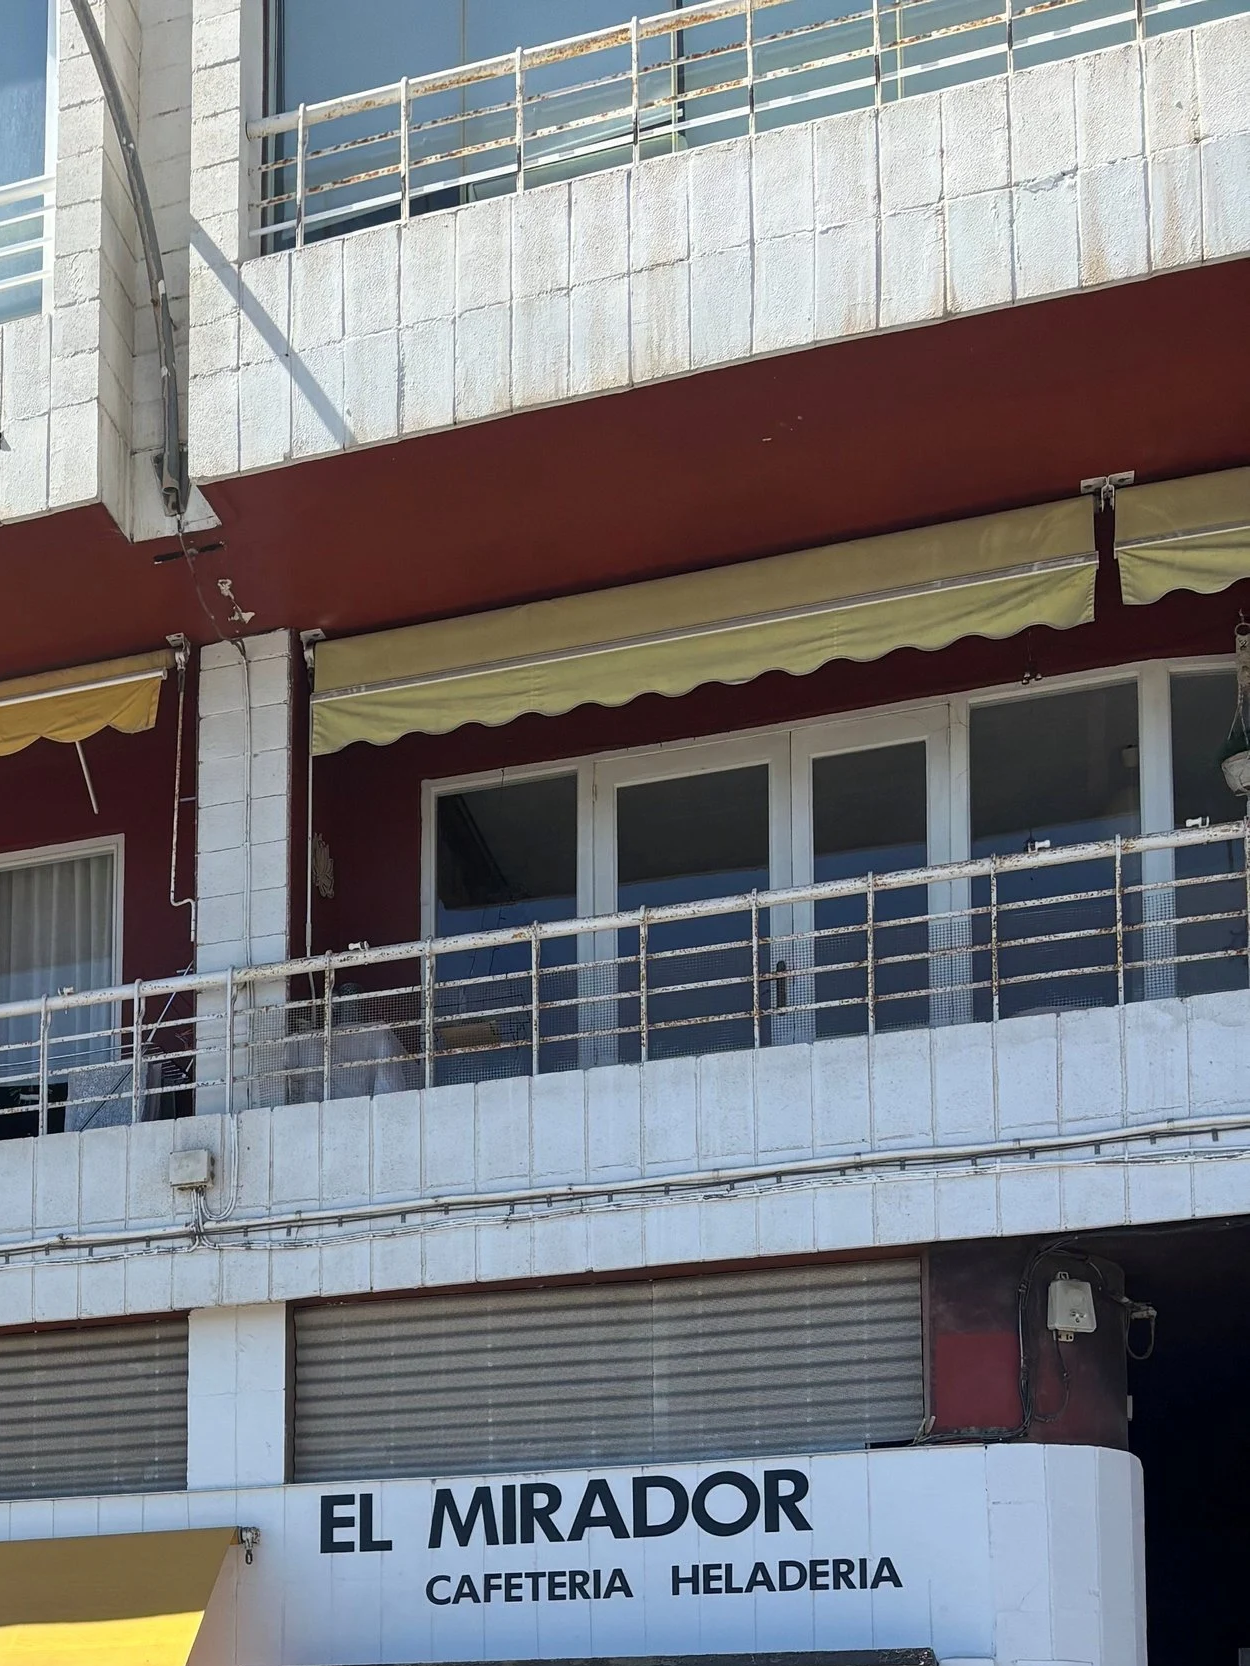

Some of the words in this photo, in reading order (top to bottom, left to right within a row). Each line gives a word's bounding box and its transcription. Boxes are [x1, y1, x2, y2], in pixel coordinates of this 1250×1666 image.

[319, 1492, 393, 1554] EL
[427, 1468, 813, 1549] MIRADOR
[424, 1567, 634, 1605] CAFETERIA
[671, 1556, 903, 1596] HELADERIA
